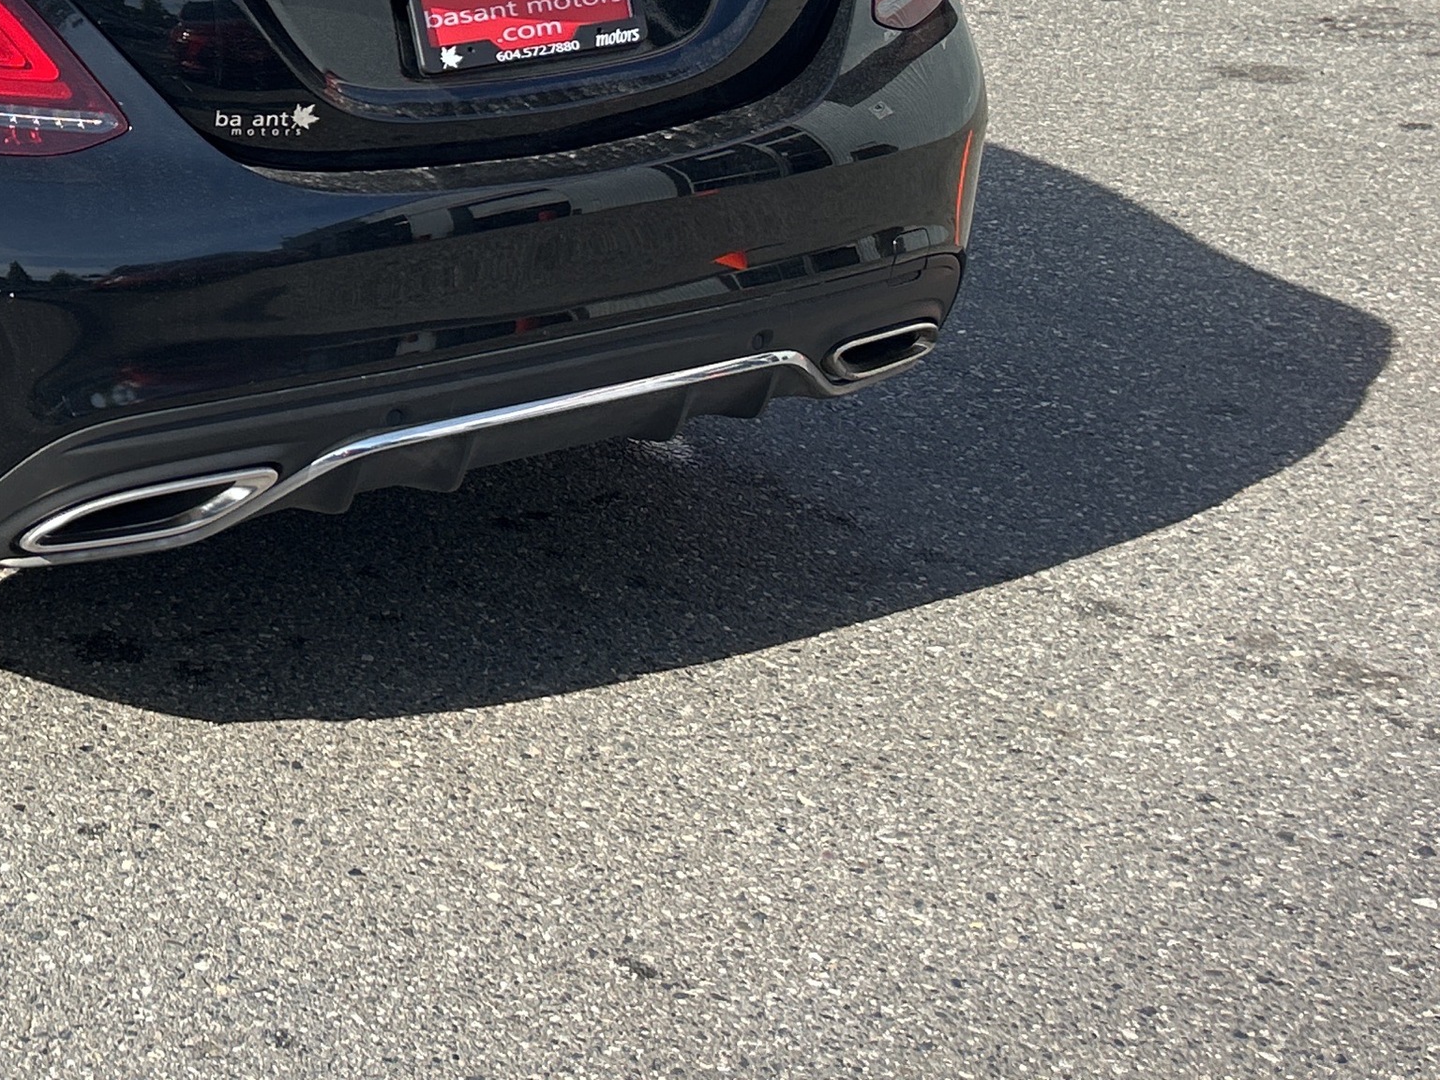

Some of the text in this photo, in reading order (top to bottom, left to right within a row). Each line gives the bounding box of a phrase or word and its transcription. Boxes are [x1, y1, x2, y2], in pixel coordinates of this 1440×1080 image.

[425, 1, 518, 29] basant
[497, 21, 562, 43] .com
[595, 27, 640, 47] motors
[496, 40, 580, 63] 604.572.7880
[231, 127, 301, 137] motors
